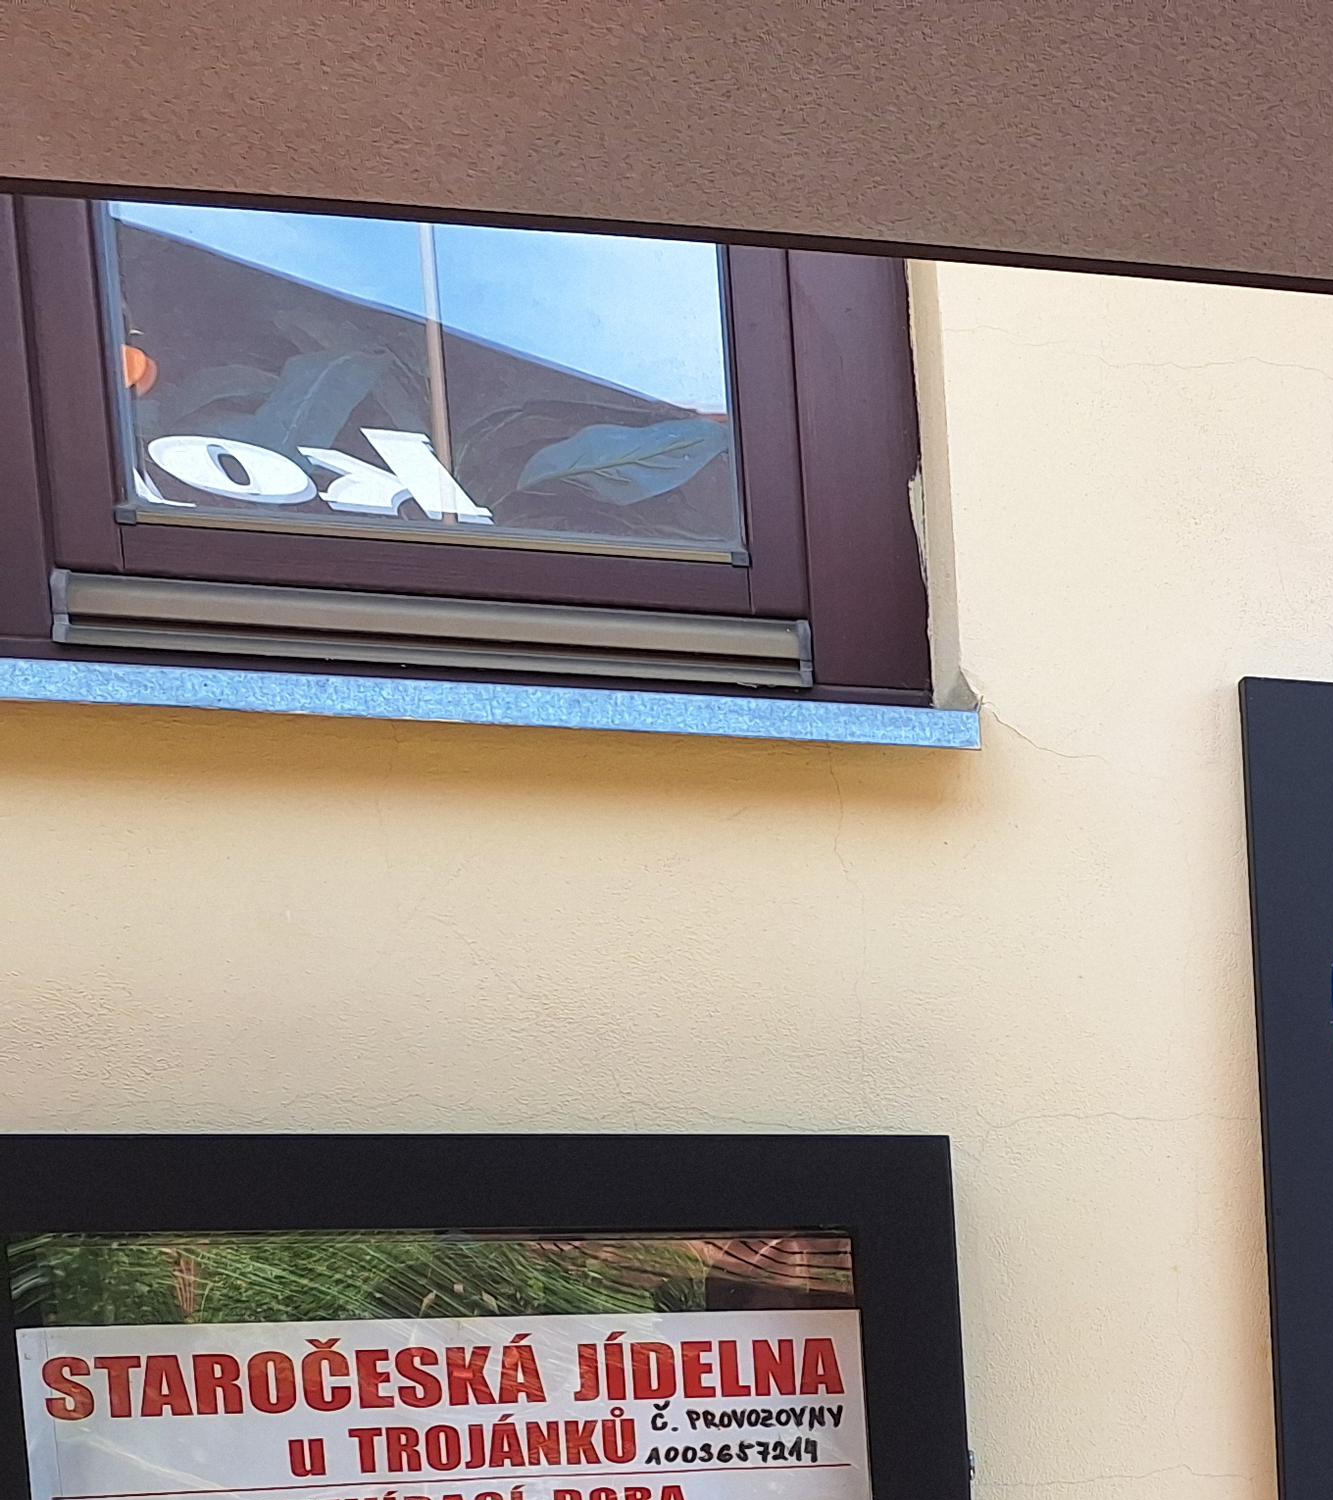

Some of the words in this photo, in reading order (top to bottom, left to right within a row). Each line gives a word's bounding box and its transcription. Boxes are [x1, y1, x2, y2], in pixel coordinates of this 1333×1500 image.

[42, 1332, 547, 1420] STAROČESKÁ
[573, 1331, 845, 1401] JÍDELNA
[288, 1437, 326, 1476] u
[348, 1406, 636, 1474] TROJÁNKŮ
[651, 1400, 679, 1431] Č.
[686, 1405, 843, 1431] PROVOZOVNY
